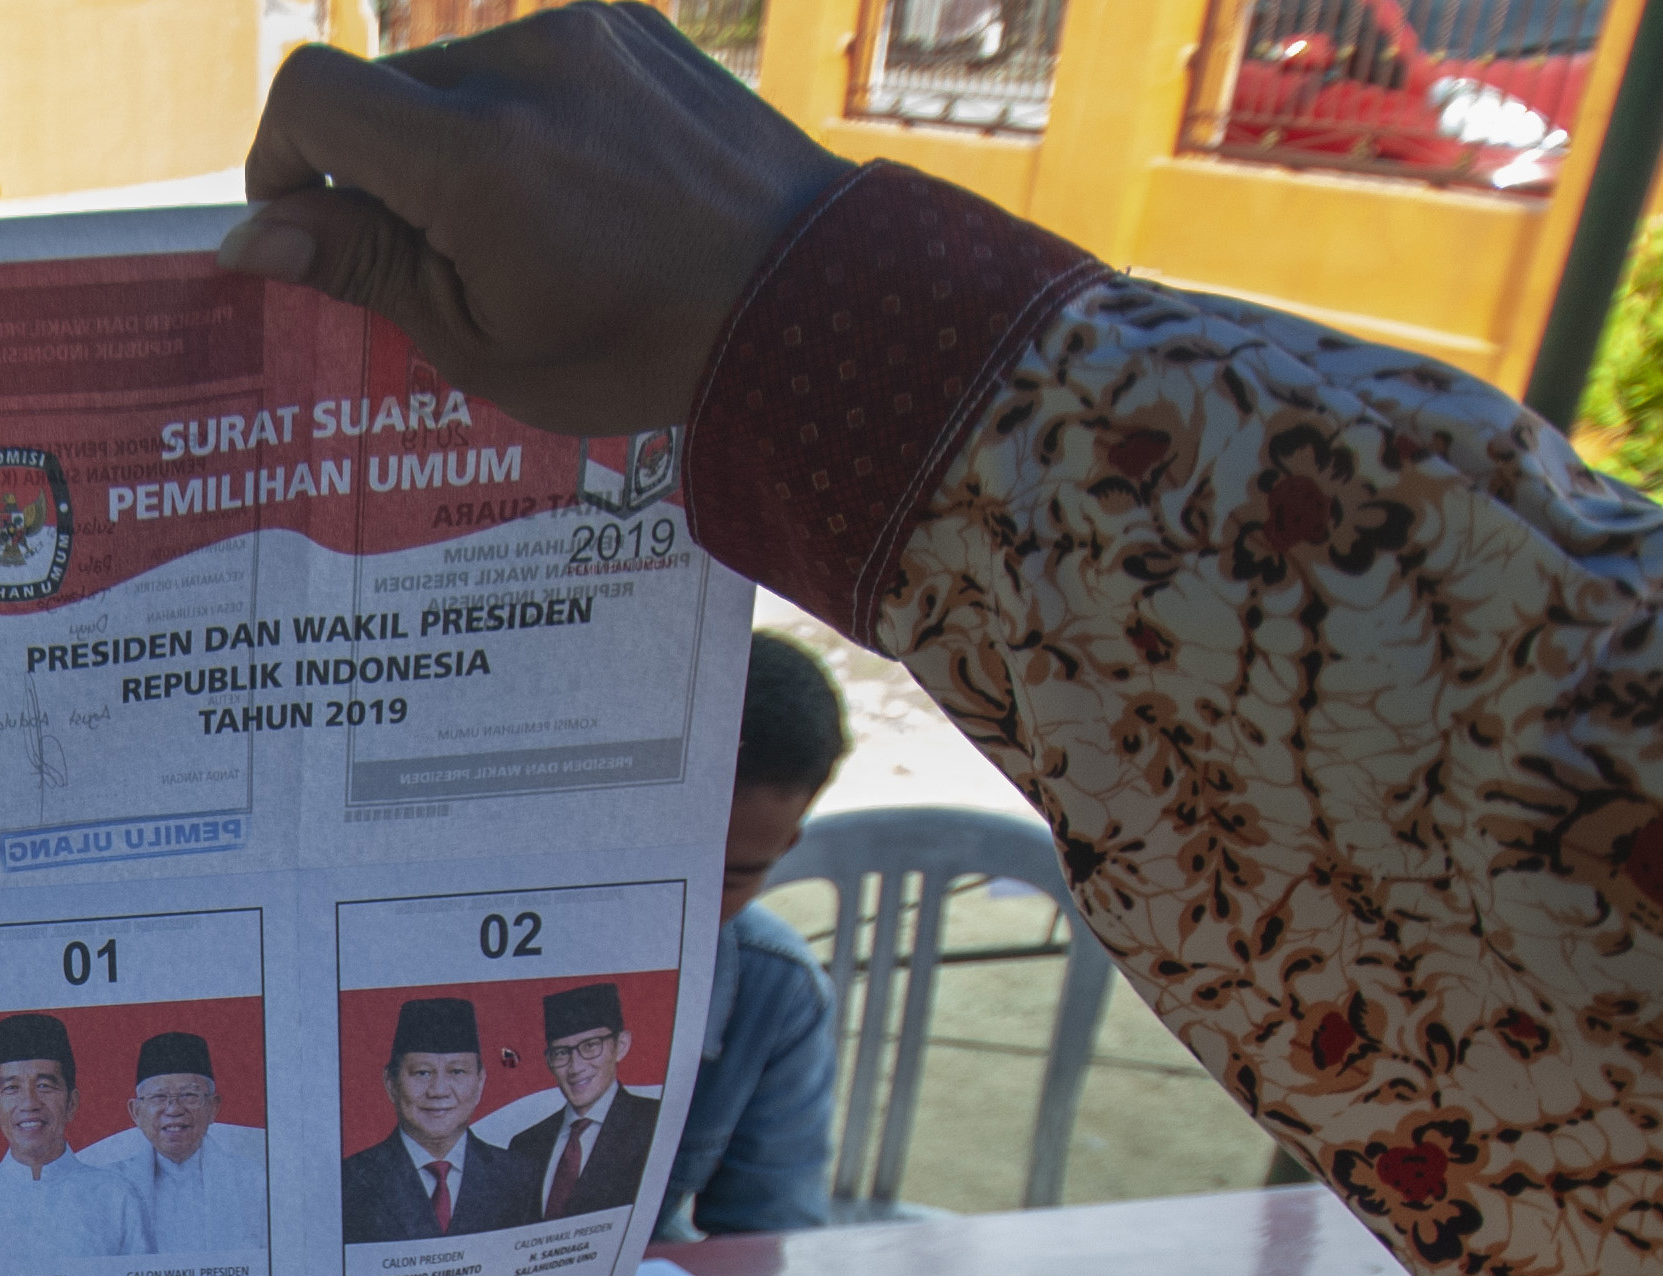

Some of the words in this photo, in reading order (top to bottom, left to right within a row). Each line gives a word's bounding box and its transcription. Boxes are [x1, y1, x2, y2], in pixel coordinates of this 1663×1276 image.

[160, 404, 300, 461] SURAT
[312, 388, 473, 440] SUARA
[108, 457, 352, 523] PEMILIHAN
[368, 444, 523, 494] UMUM
[40, 533, 70, 595] UMUM
[568, 517, 676, 564] 2019
[26, 630, 192, 673] PRESIDEN
[204, 618, 282, 652] DAN
[292, 609, 408, 645] WAKIL
[420, 598, 593, 638] PRESIDEN
[122, 661, 284, 703] REPUBLIK
[295, 650, 491, 688] INDONESIA
[198, 701, 313, 736] TAHUN
[326, 697, 410, 730] 2019
[479, 910, 543, 960] 02
[62, 938, 118, 987] 01
[382, 1255, 417, 1269] CALON
[419, 1249, 465, 1266] PRESIDEN
